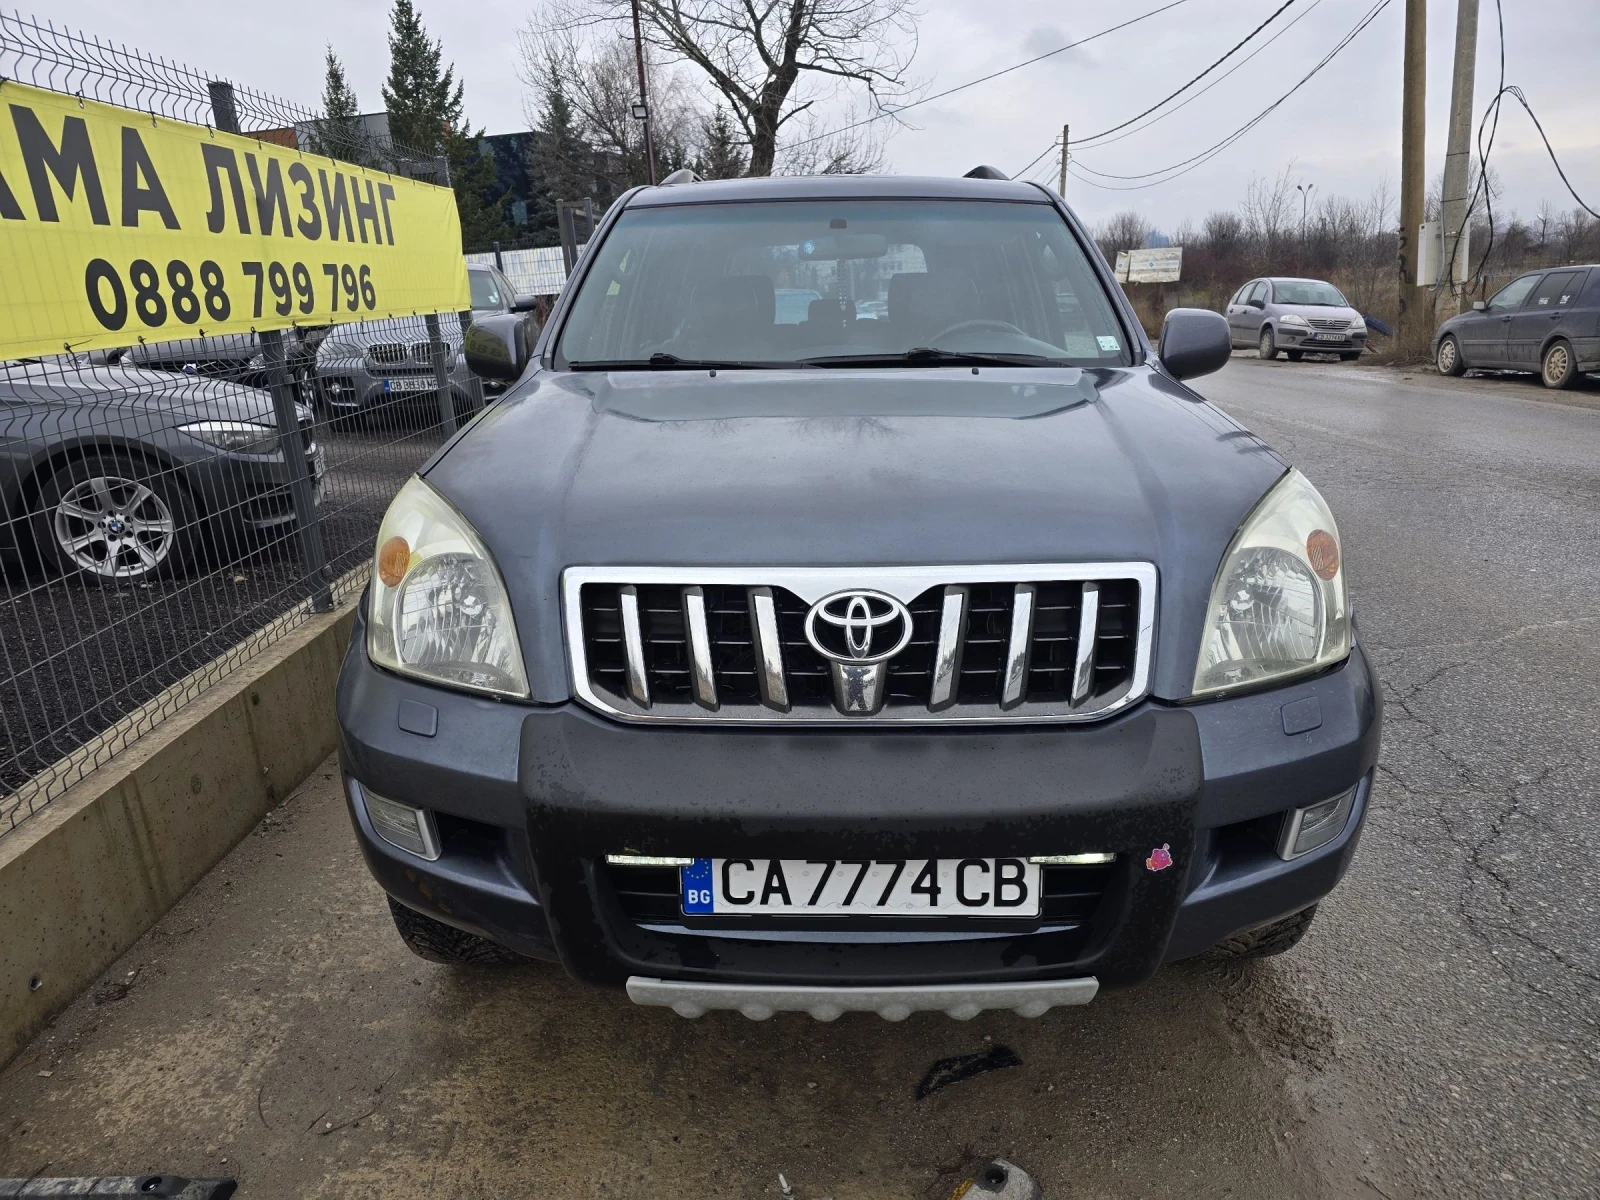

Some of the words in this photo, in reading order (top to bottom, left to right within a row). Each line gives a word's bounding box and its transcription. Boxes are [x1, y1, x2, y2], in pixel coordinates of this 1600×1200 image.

[200, 142, 396, 246] ЛИЗИНГ
[85, 258, 231, 331] 0888
[241, 261, 315, 318] 799
[322, 263, 377, 312] 796
[688, 889, 711, 904] BG
[721, 858, 792, 906] CA
[806, 859, 942, 907] 7774
[956, 858, 1028, 908] CB
